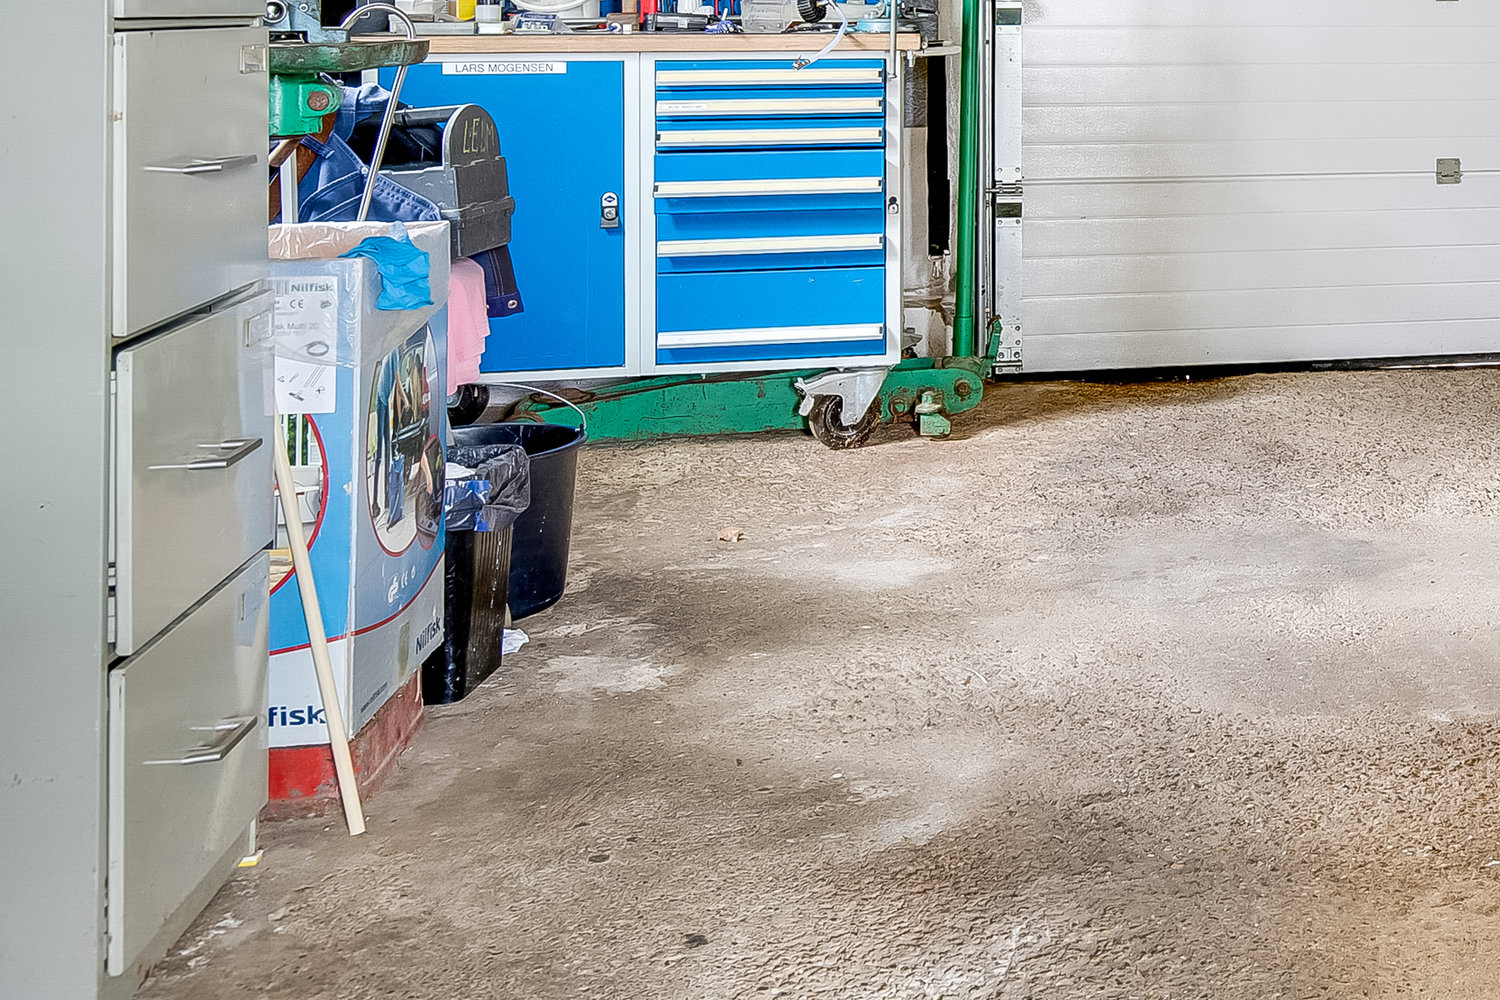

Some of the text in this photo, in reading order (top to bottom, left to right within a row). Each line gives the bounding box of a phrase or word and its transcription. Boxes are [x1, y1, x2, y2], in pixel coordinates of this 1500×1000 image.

[455, 63, 554, 73] LARS MOGENSEN
[291, 283, 333, 292] Nilfisk
[416, 617, 440, 655] Nilfisk
[268, 705, 326, 727] fisk
